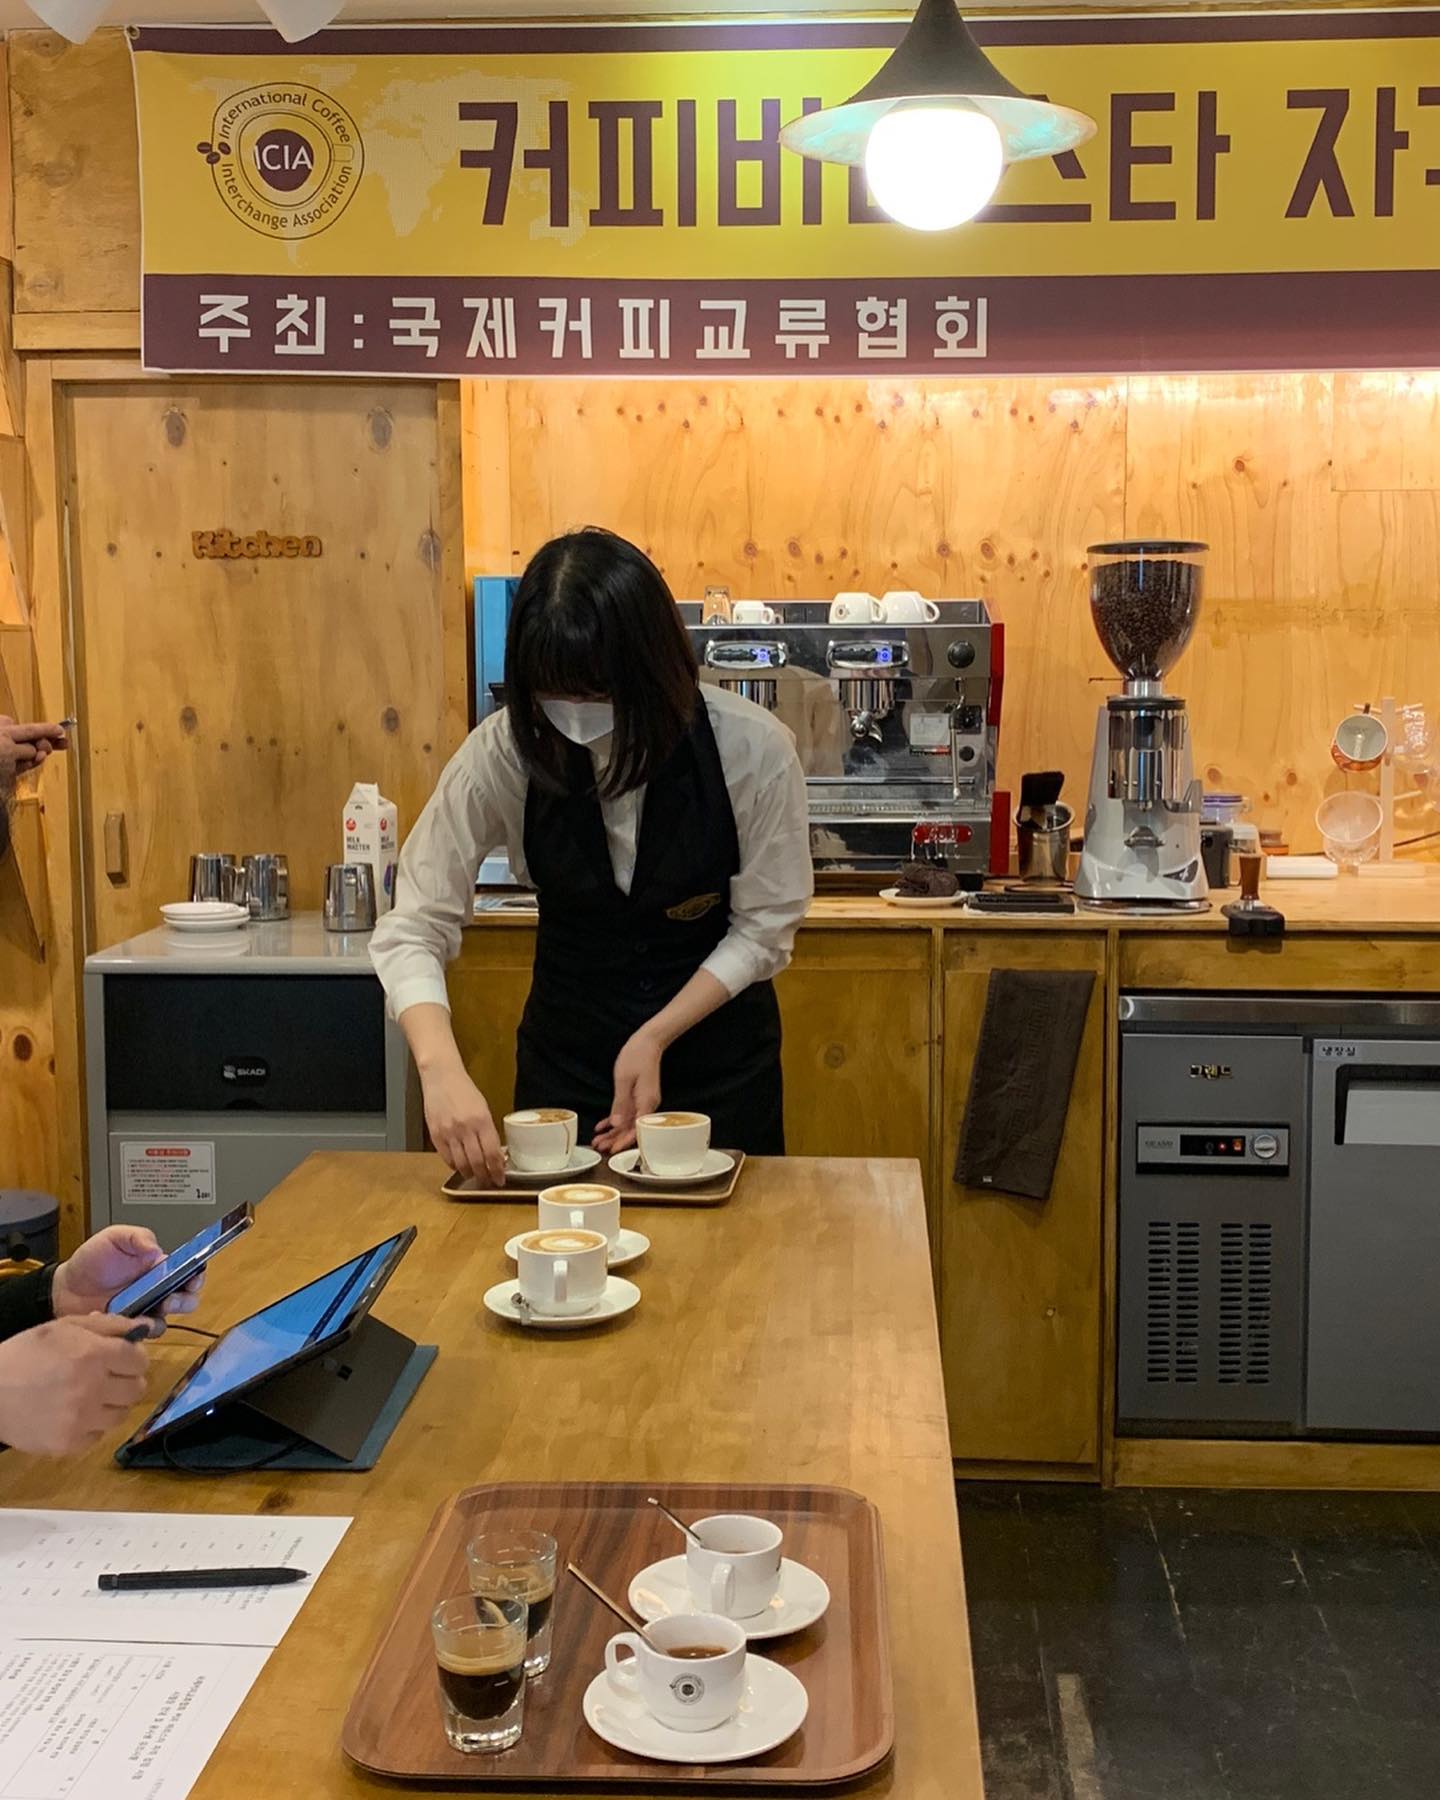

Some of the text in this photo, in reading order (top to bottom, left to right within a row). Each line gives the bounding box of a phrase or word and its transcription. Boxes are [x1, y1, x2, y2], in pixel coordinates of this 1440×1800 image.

[218, 92, 351, 143] International Coffee
[254, 144, 314, 171] ICIA
[1284, 86, 1440, 219] 자
[222, 162, 353, 231] Interchange Association
[388, 295, 988, 359] 국제커피교류협회
